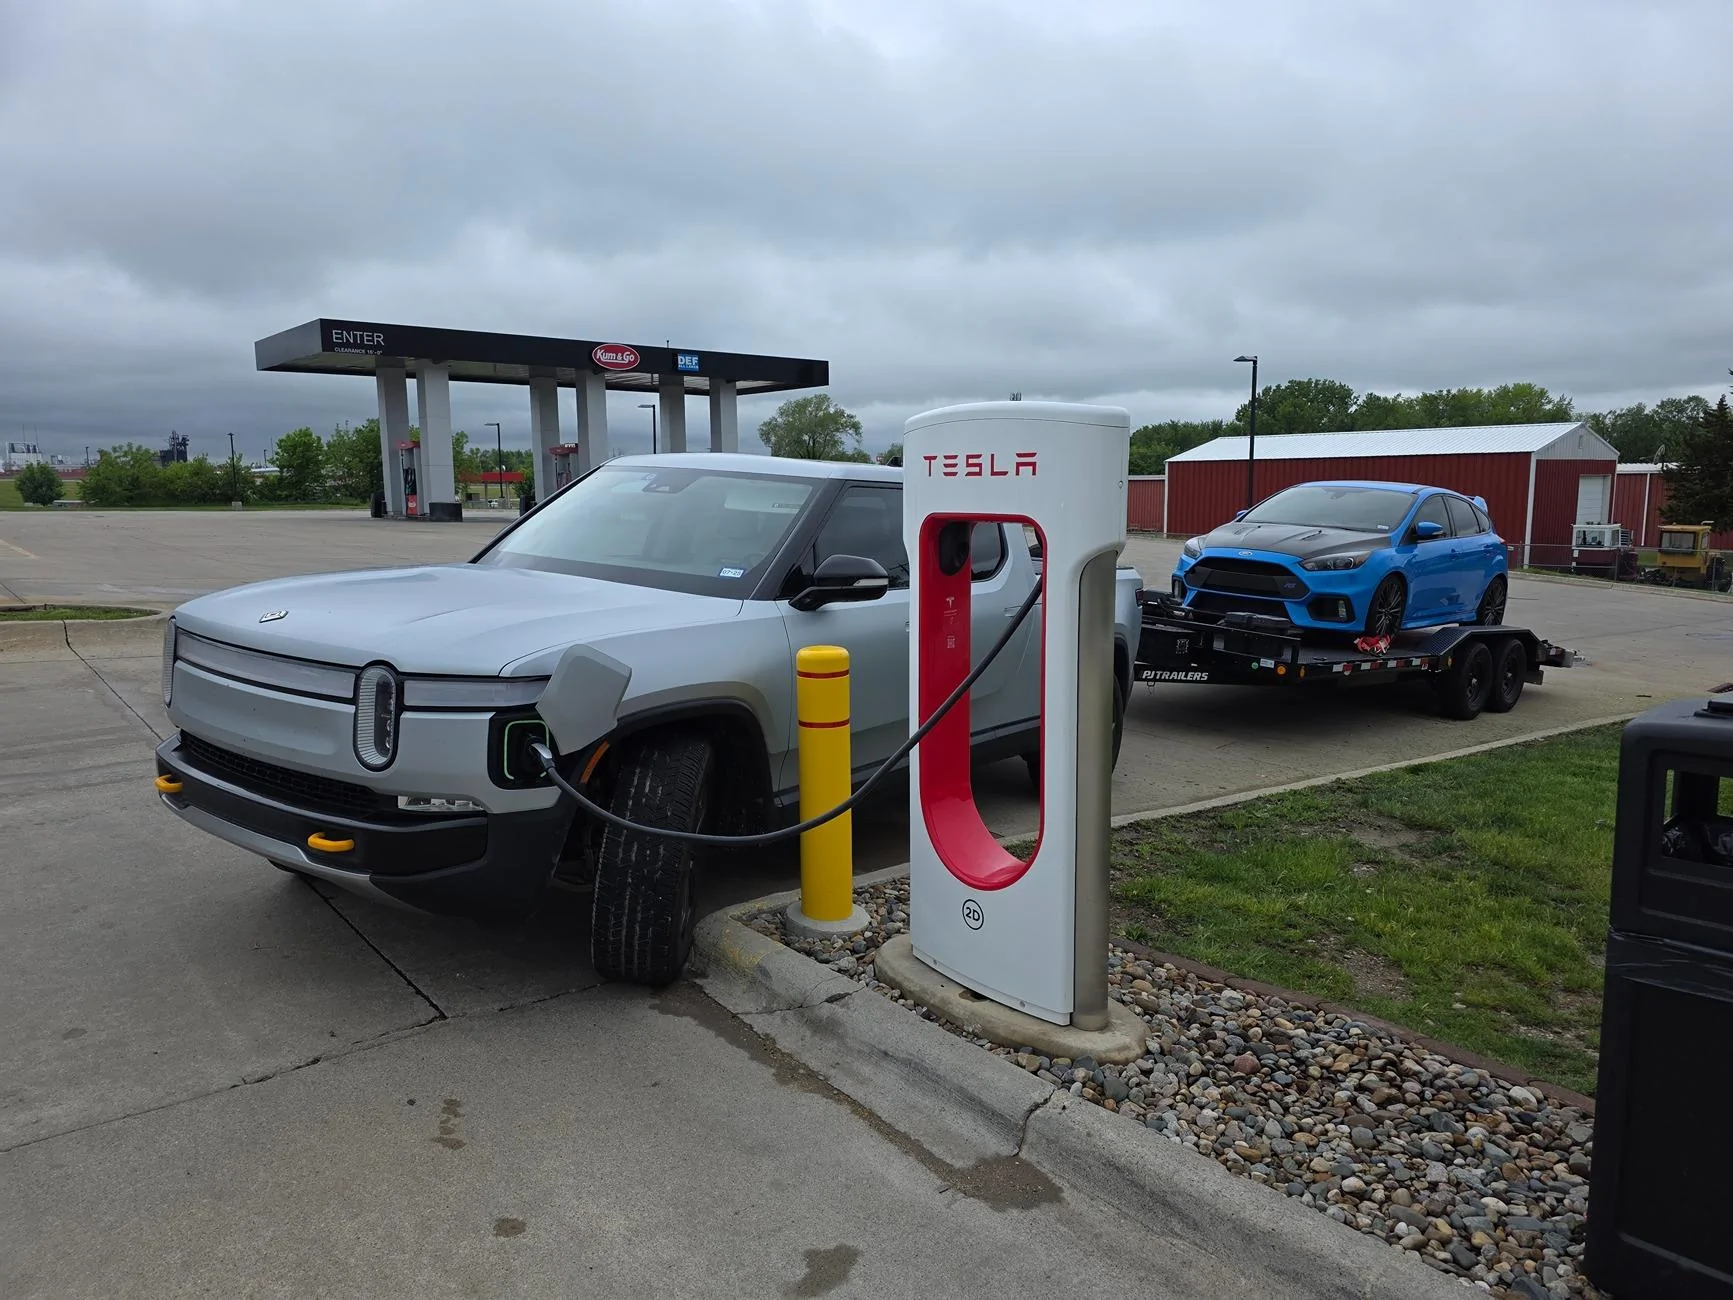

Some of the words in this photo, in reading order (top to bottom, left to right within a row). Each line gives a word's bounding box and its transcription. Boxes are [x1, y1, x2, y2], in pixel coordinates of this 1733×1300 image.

[332, 330, 384, 345] ENTER
[677, 355, 699, 366] DEF
[923, 452, 1038, 477] TESLA
[965, 906, 980, 921] 2D
